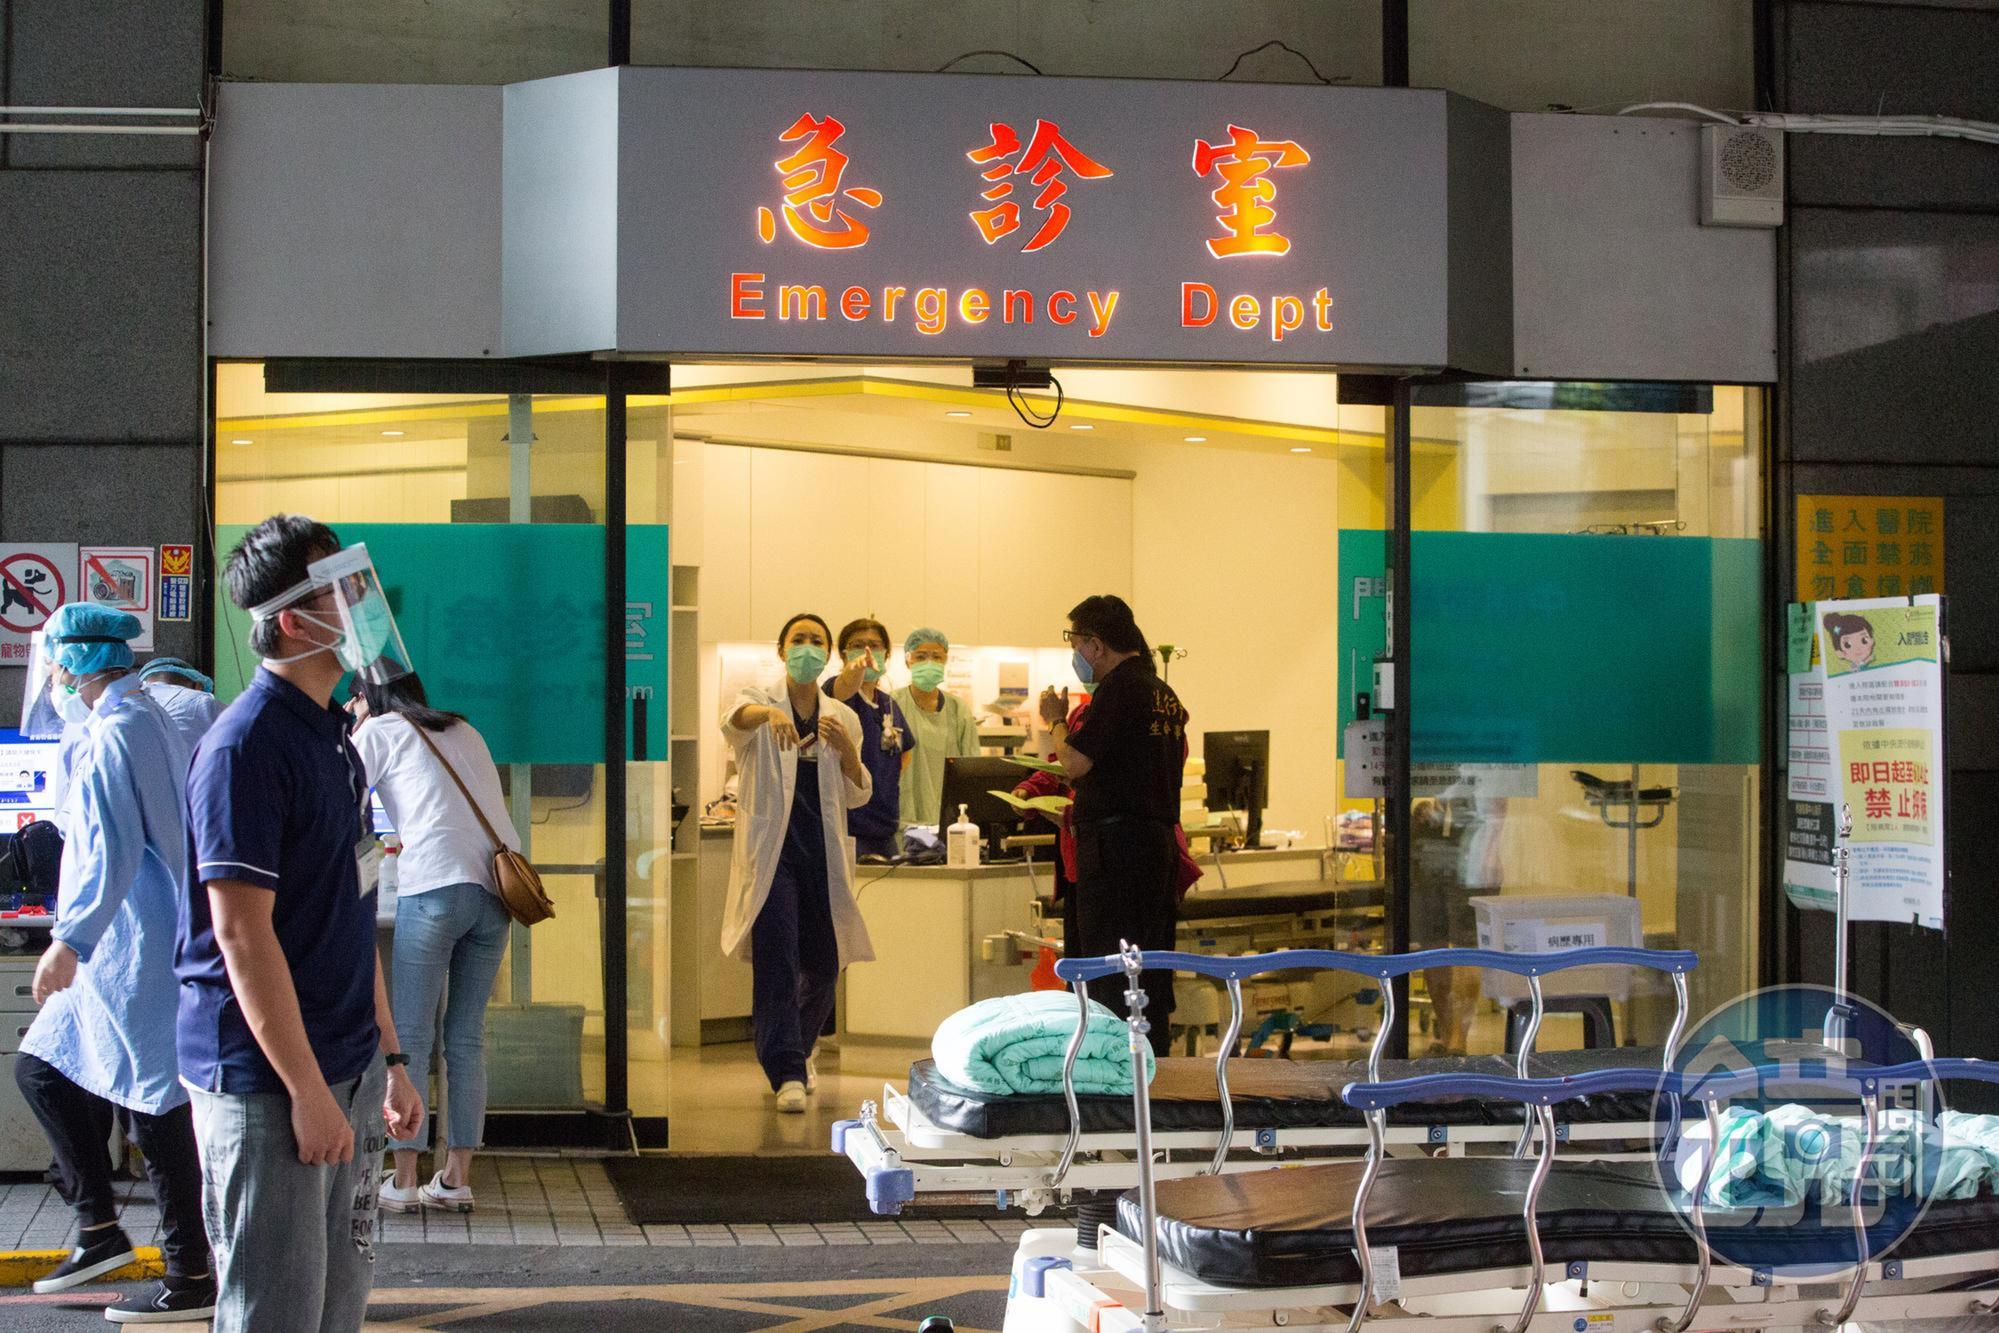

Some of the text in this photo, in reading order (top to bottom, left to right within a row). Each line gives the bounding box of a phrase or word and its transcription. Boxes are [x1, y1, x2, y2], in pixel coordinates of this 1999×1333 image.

[757, 112, 1311, 259] 急診室
[730, 272, 1334, 342] Emergency Dept
[1809, 508, 1934, 534] 進入醫院
